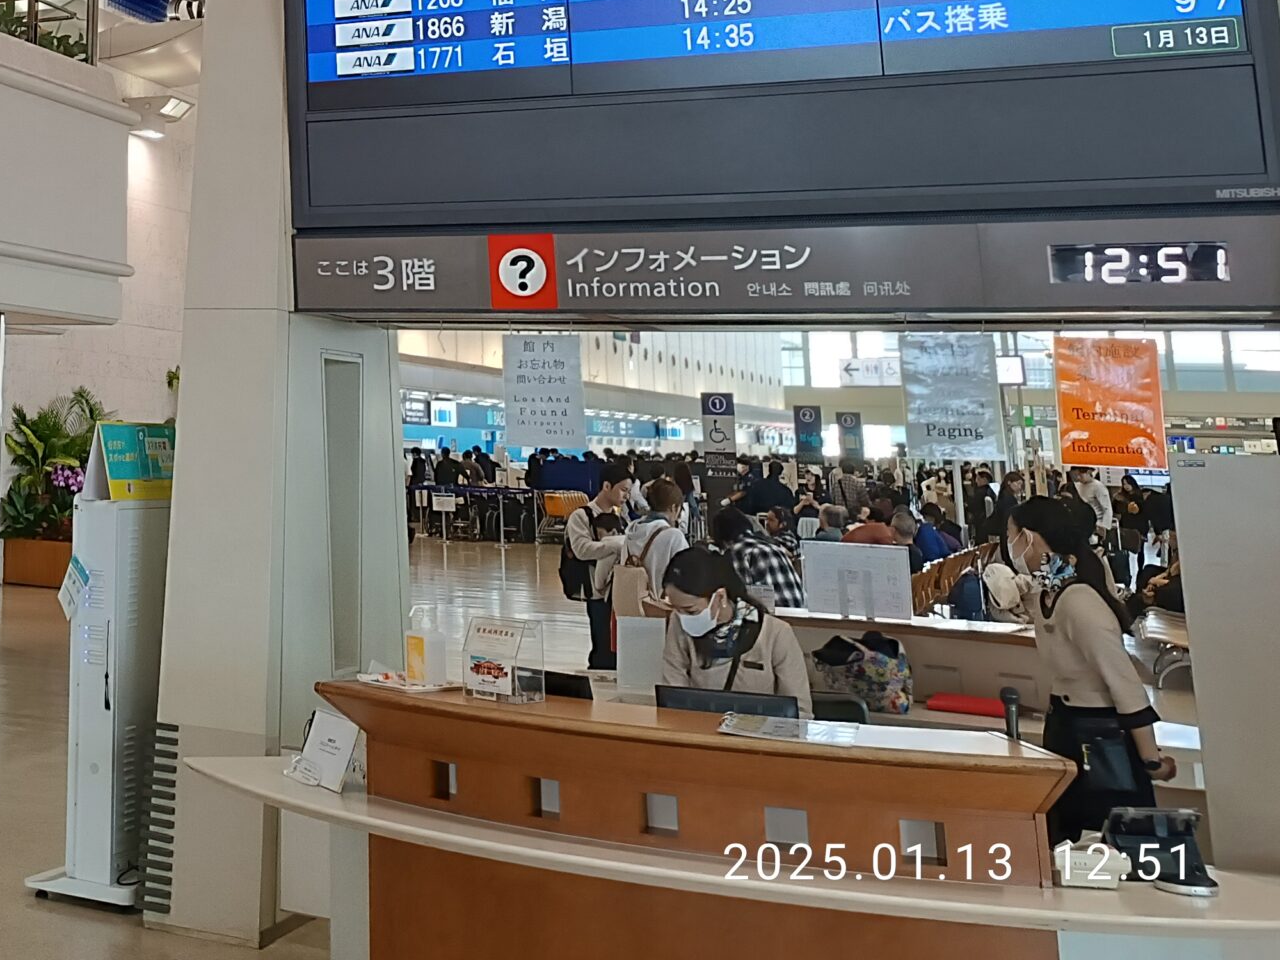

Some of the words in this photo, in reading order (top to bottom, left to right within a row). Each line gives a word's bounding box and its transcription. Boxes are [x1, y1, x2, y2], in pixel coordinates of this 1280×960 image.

[416, 15, 464, 40] 1866
[418, 45, 461, 69] 1771
[683, 23, 754, 49] 14:35
[884, 2, 1008, 33] バス搭乗
[566, 245, 811, 274] インフォメーション
[1084, 246, 1226, 284] 12:51
[568, 276, 720, 297] Information
[746, 281, 793, 297] 안내소
[517, 358, 565, 370] お忘れ物
[516, 374, 568, 385] 問い合わせ
[519, 407, 568, 417] Found
[925, 423, 984, 440] Paging
